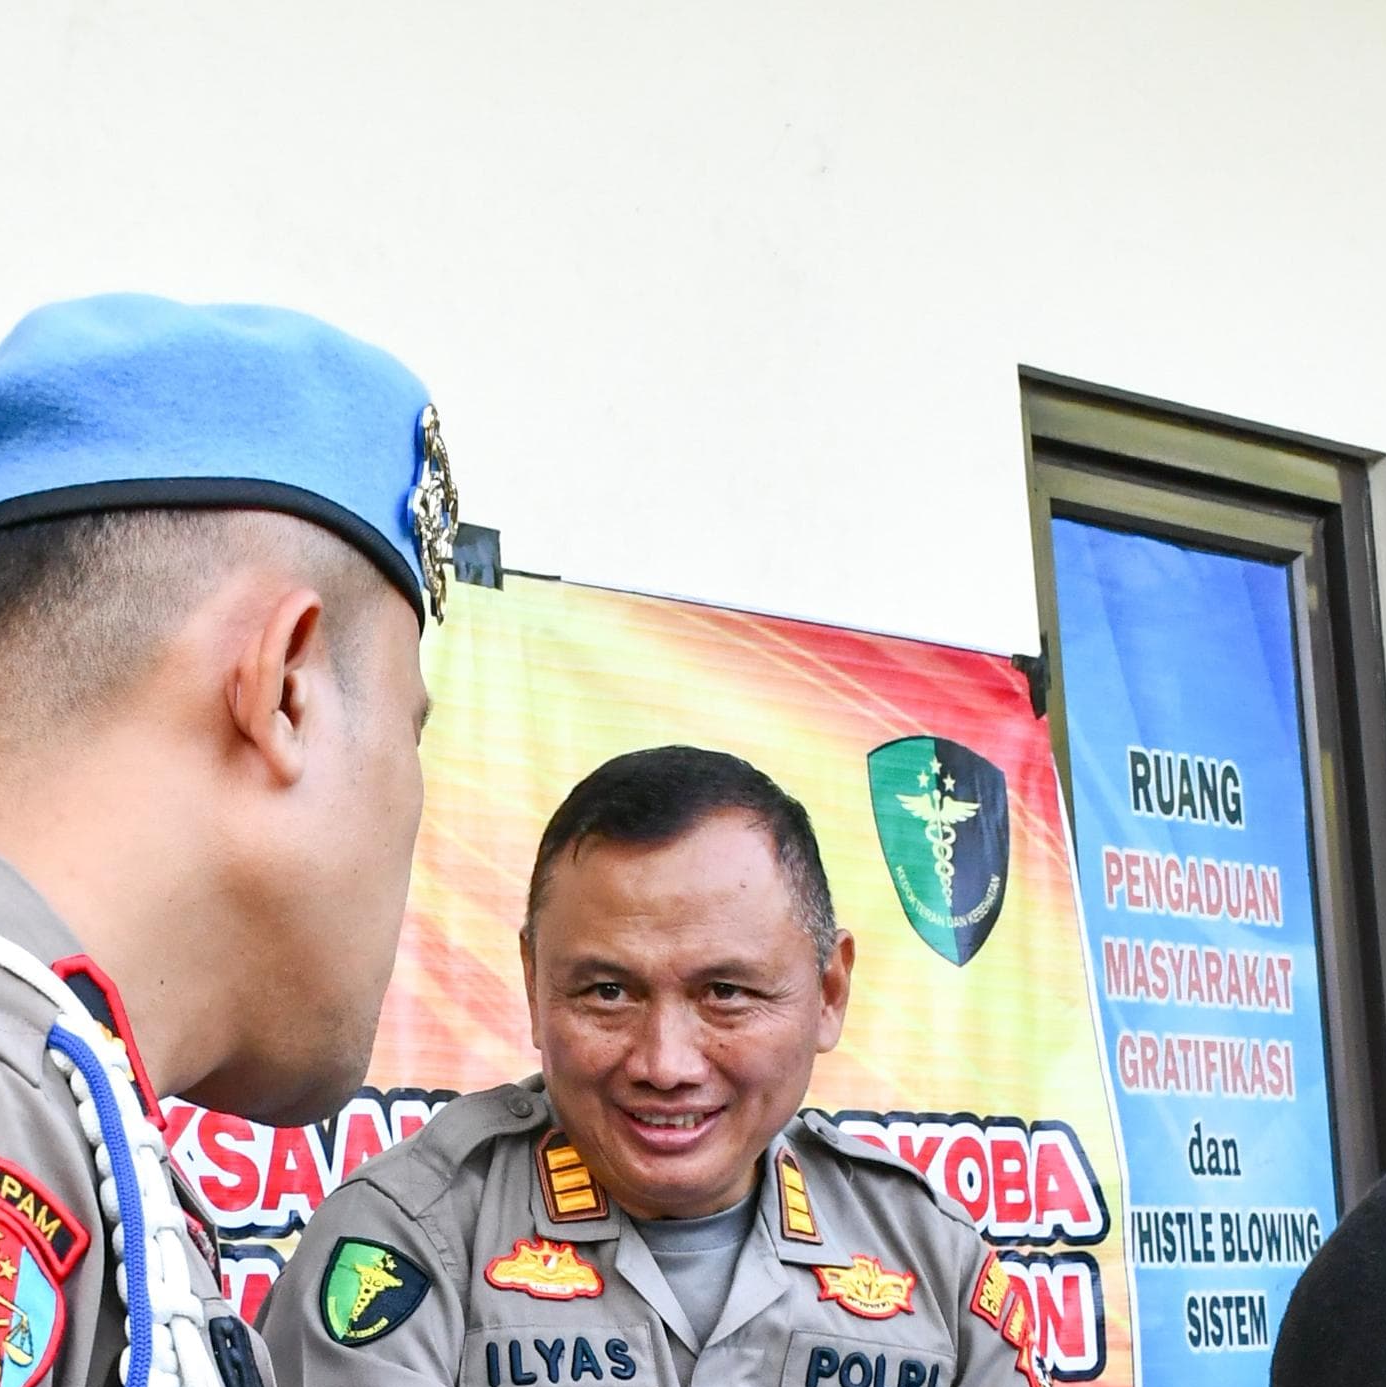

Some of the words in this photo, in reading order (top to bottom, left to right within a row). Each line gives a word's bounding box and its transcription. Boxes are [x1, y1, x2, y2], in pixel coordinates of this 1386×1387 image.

[1129, 749, 1243, 825] RUANG
[1104, 850, 1282, 923] PENGADUAN
[1103, 940, 1292, 1011] MASYARAKAT
[1118, 1034, 1294, 1098] GRATIFIKASI
[848, 1133, 1093, 1225] KOBA
[1188, 1121, 1242, 1176] dan
[1131, 1211, 1216, 1264] HISTLE
[1220, 1212, 1321, 1263] BLOWING
[1186, 1295, 1269, 1348] SISTEM
